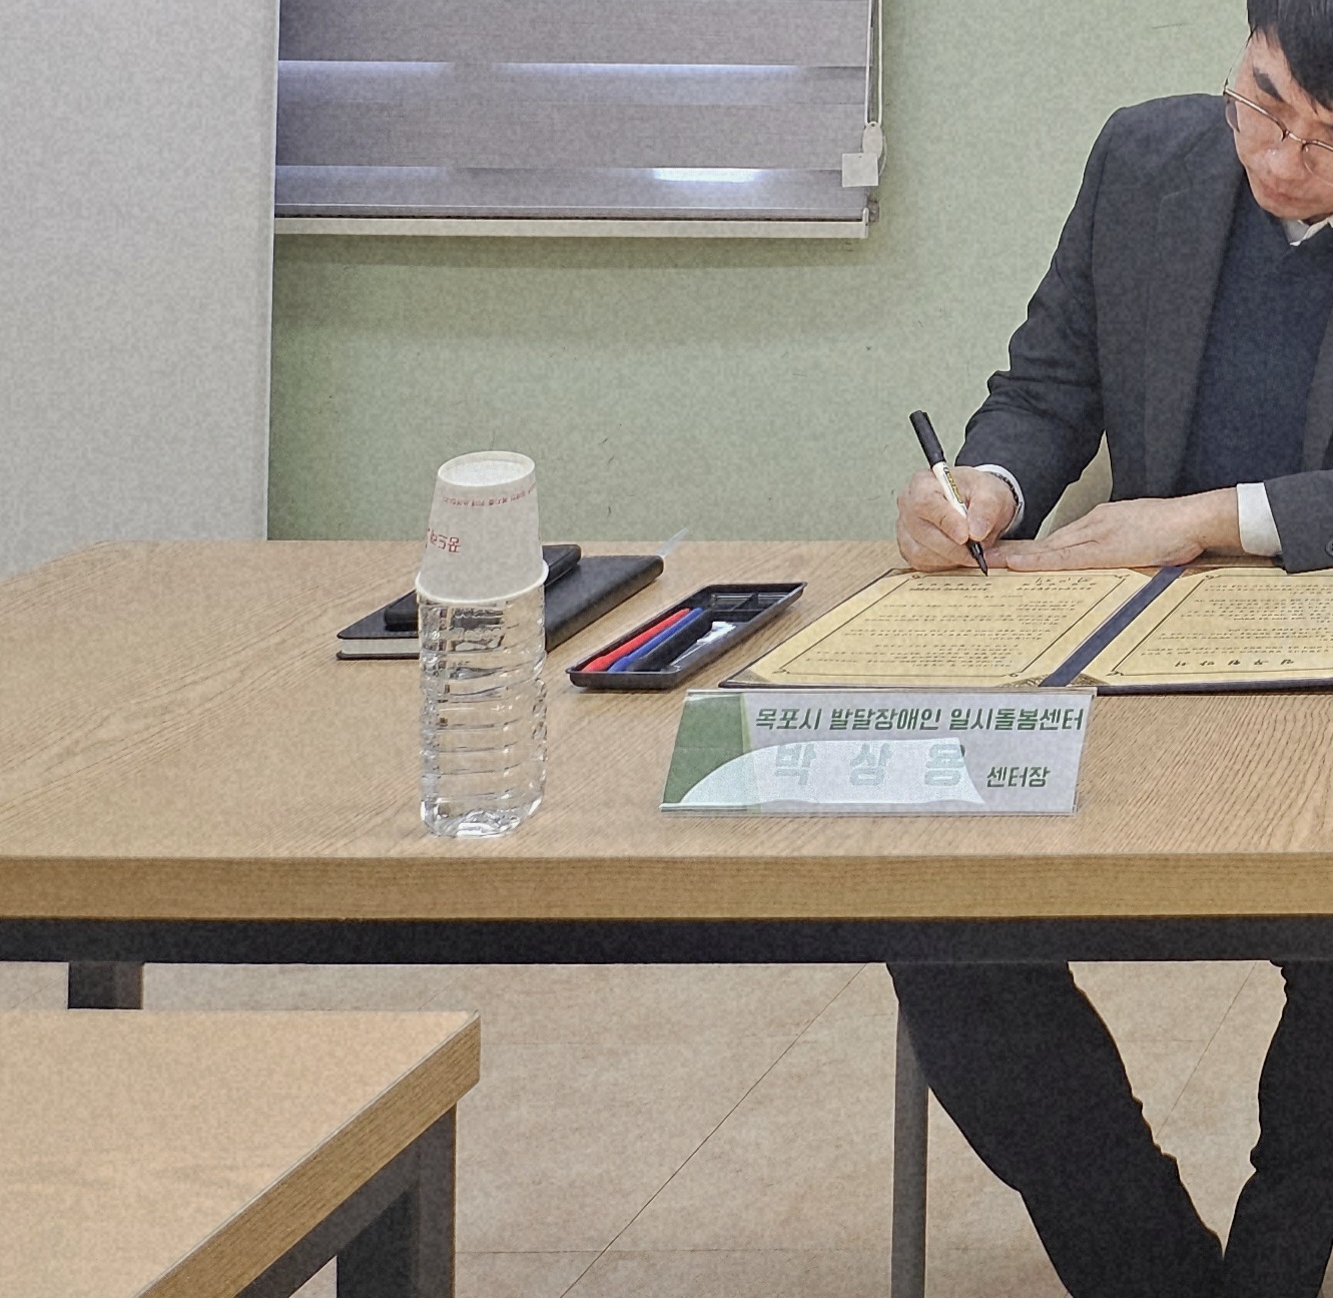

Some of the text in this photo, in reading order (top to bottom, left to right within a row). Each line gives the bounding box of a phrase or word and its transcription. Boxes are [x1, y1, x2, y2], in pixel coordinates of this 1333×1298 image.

[756, 708, 1085, 731] 목포시 발달장애인 일시돌봄센터
[986, 766, 1050, 788] 센터장
